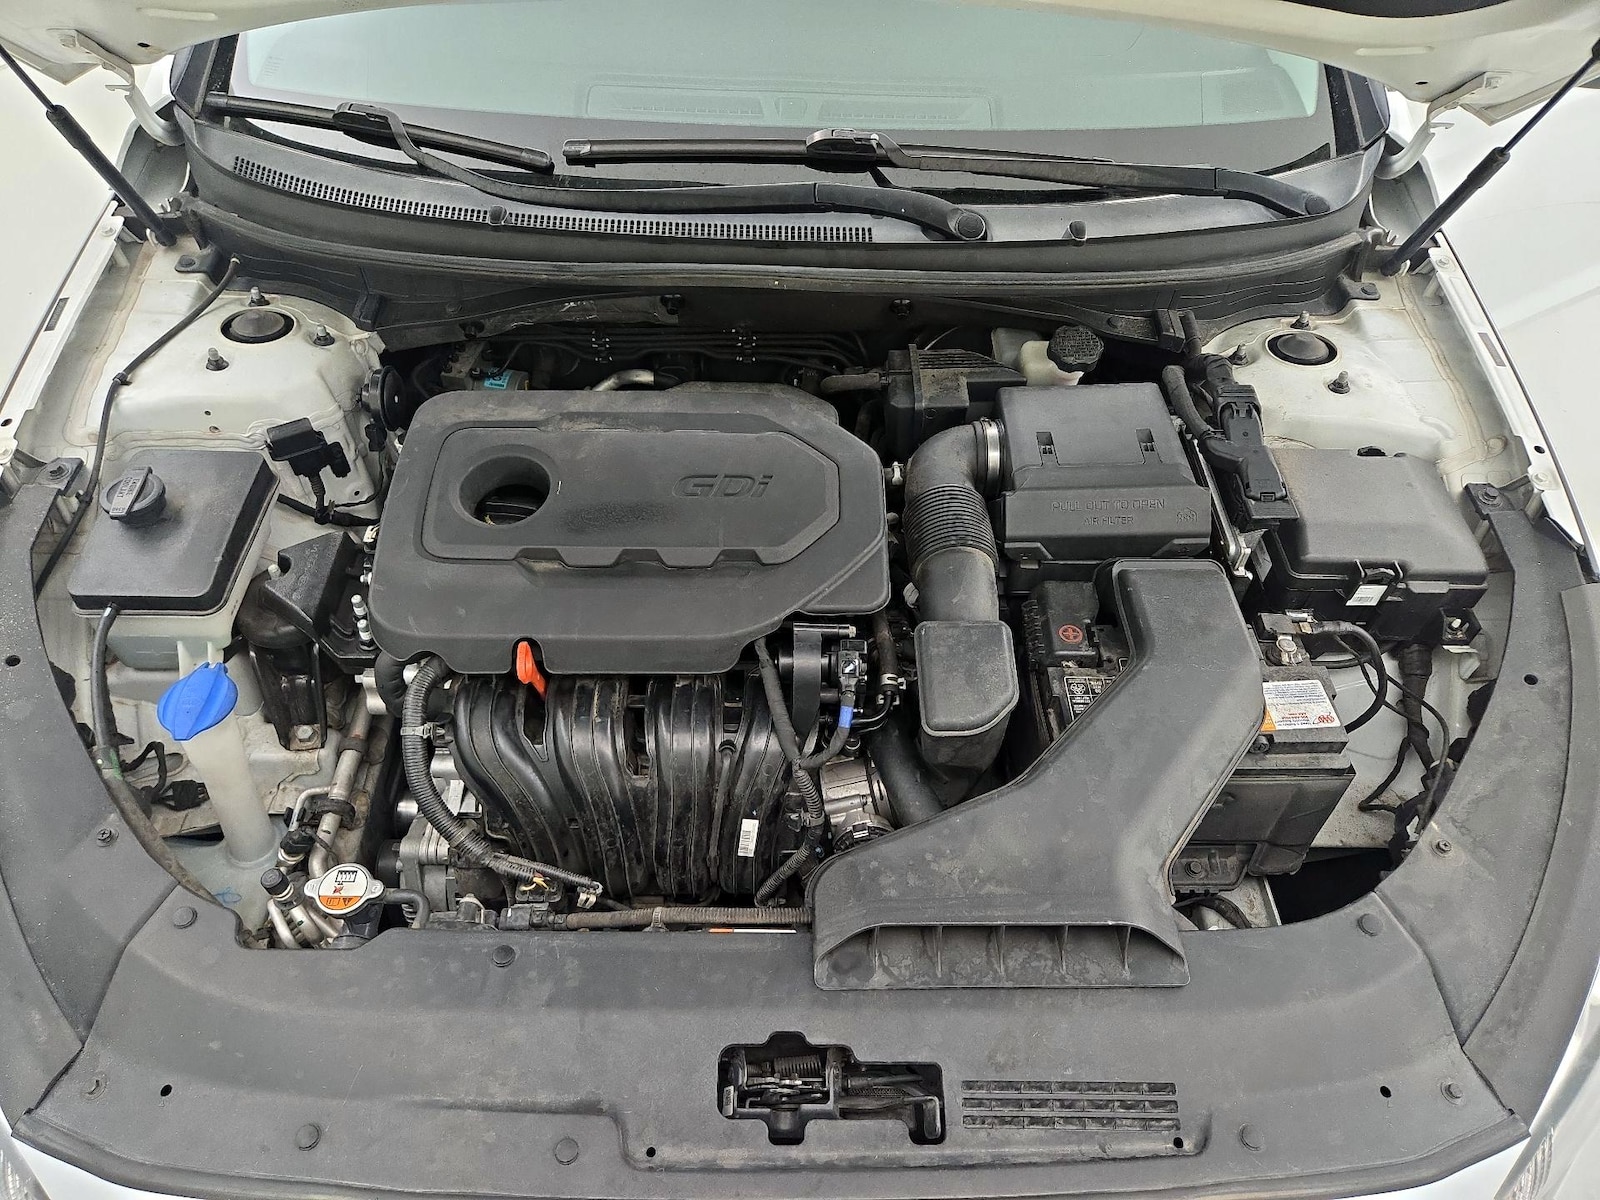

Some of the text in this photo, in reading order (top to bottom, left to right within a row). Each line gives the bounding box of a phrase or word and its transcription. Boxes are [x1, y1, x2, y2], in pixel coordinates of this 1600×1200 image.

[672, 474, 774, 498] GDi
[1052, 498, 1165, 512] PULL OUT TO OPEN
[1083, 515, 1134, 526] AIR FILTER
